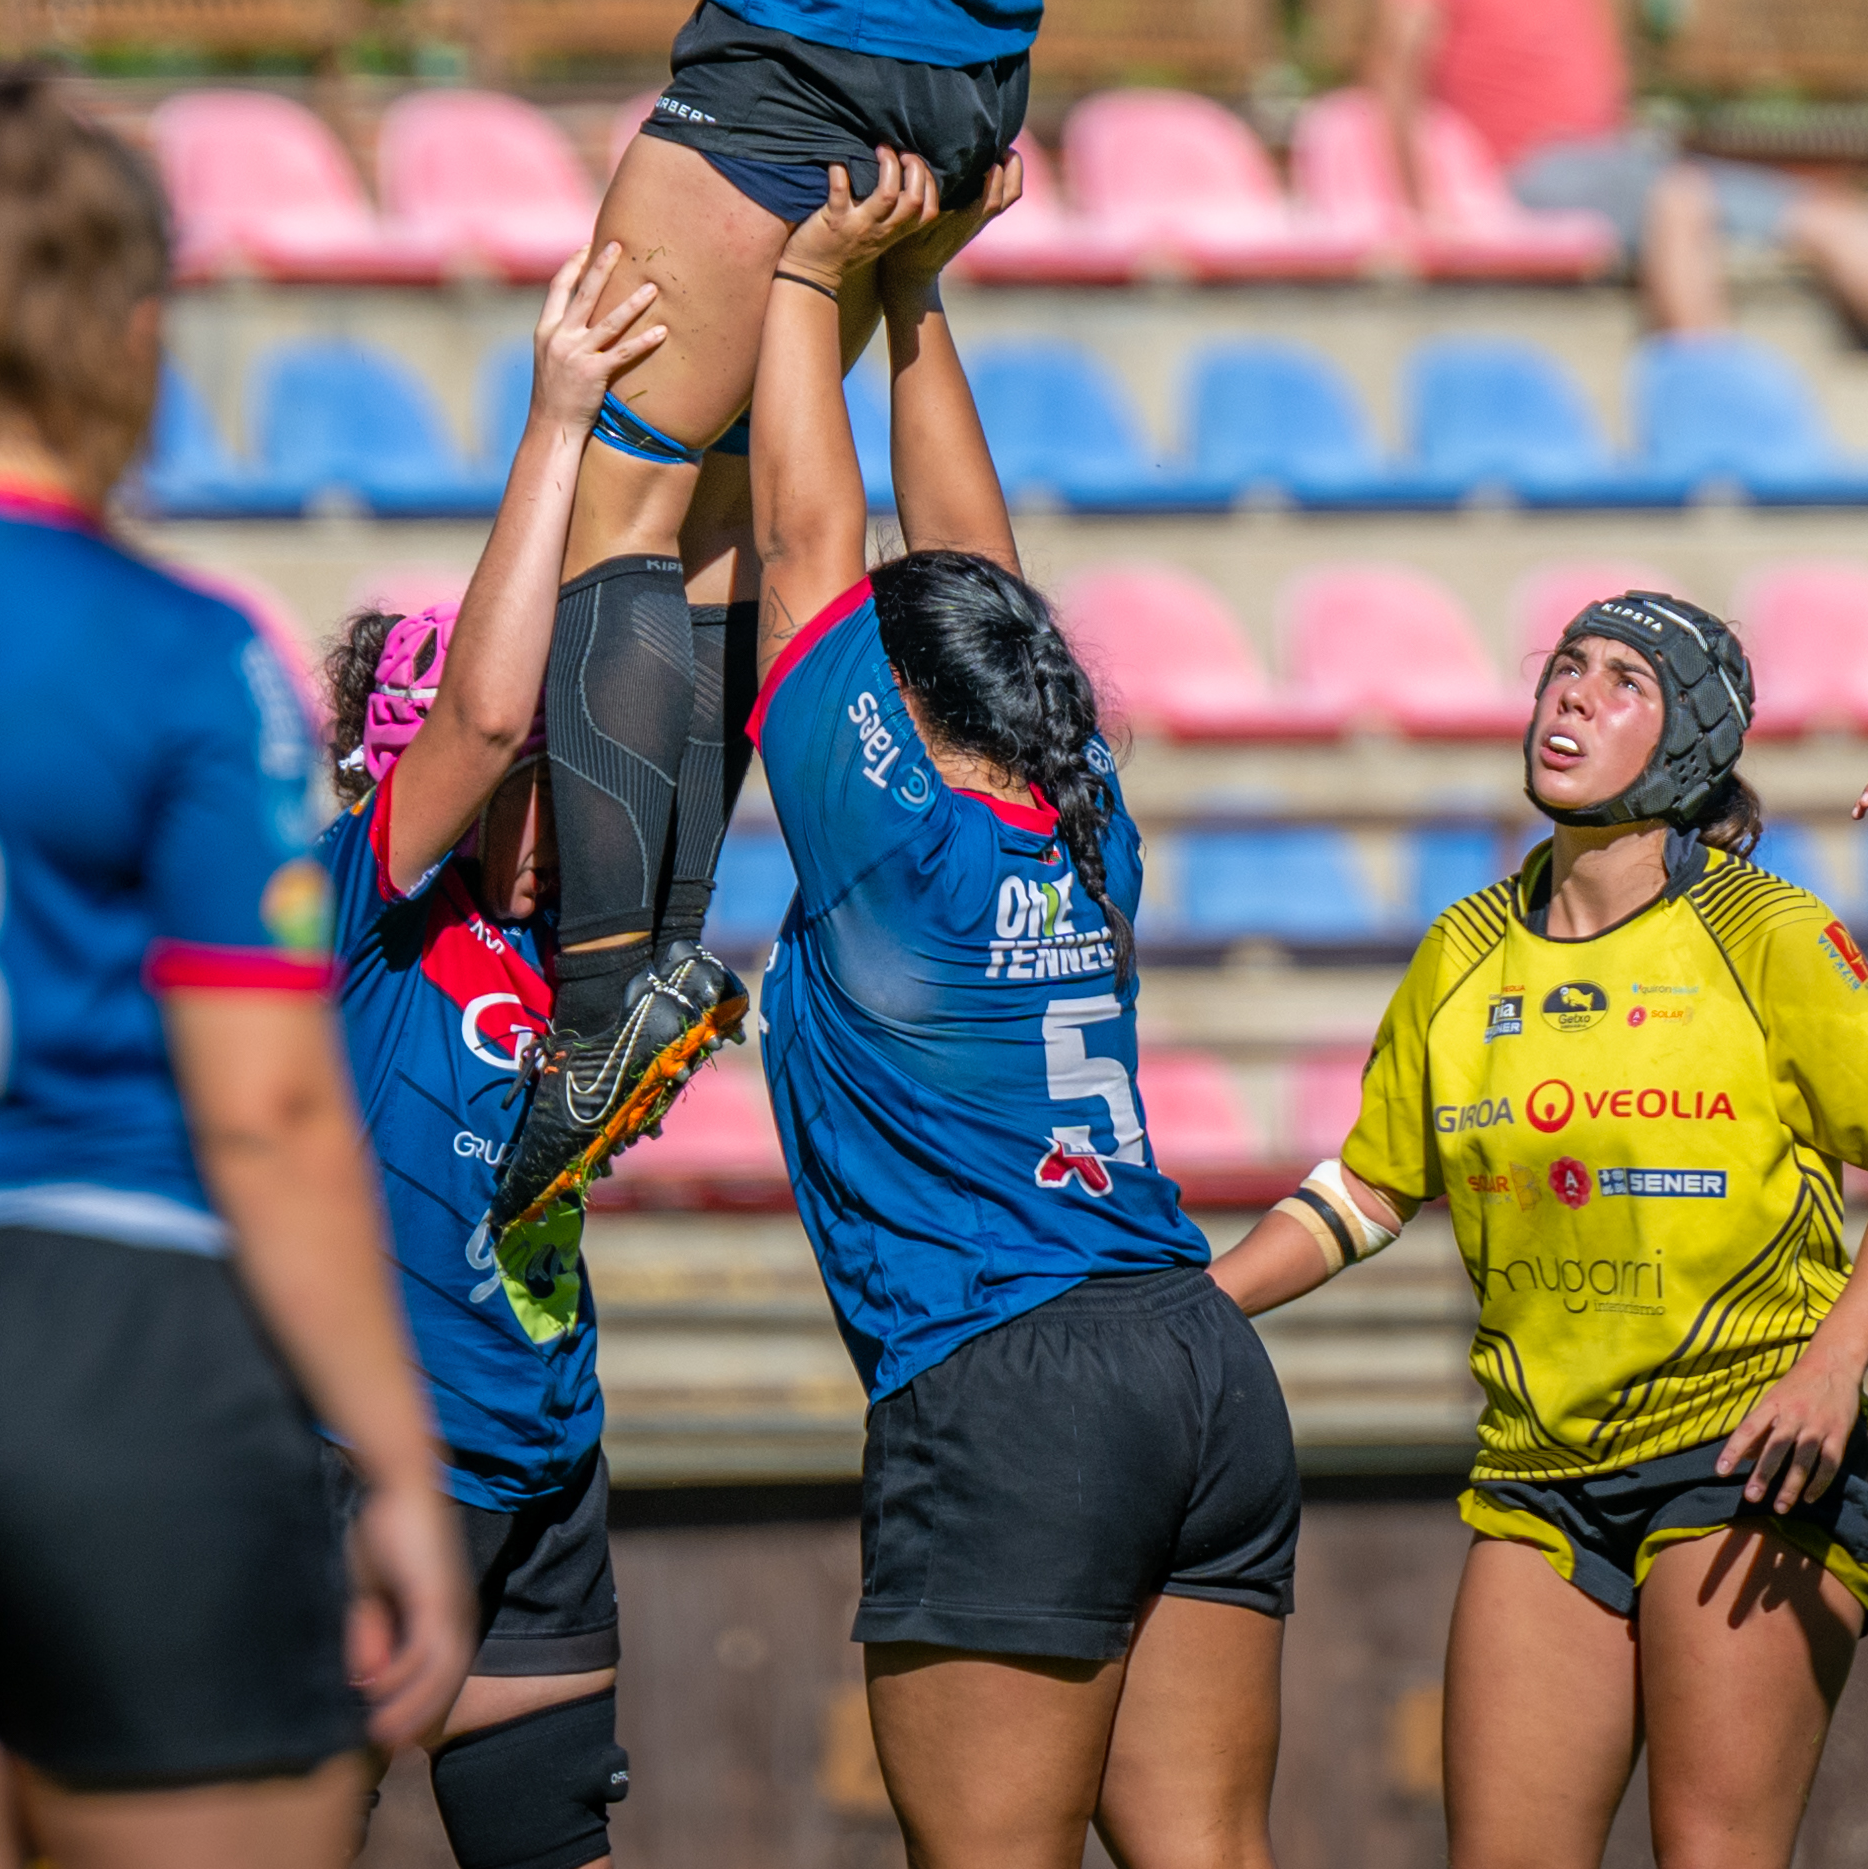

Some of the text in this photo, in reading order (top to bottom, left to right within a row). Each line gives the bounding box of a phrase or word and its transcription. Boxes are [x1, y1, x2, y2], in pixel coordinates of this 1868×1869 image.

[646, 559, 684, 574] KIP
[1601, 602, 1663, 632] KIPSTA
[847, 691, 901, 789] Taes
[995, 871, 1076, 939] ONE
[985, 926, 1115, 980] TENNEC
[1041, 993, 1145, 1166] 5
[1433, 1097, 1514, 1133] GIROA
[1584, 1088, 1737, 1121] VEOLIA
[1629, 1173, 1723, 1194] SENER
